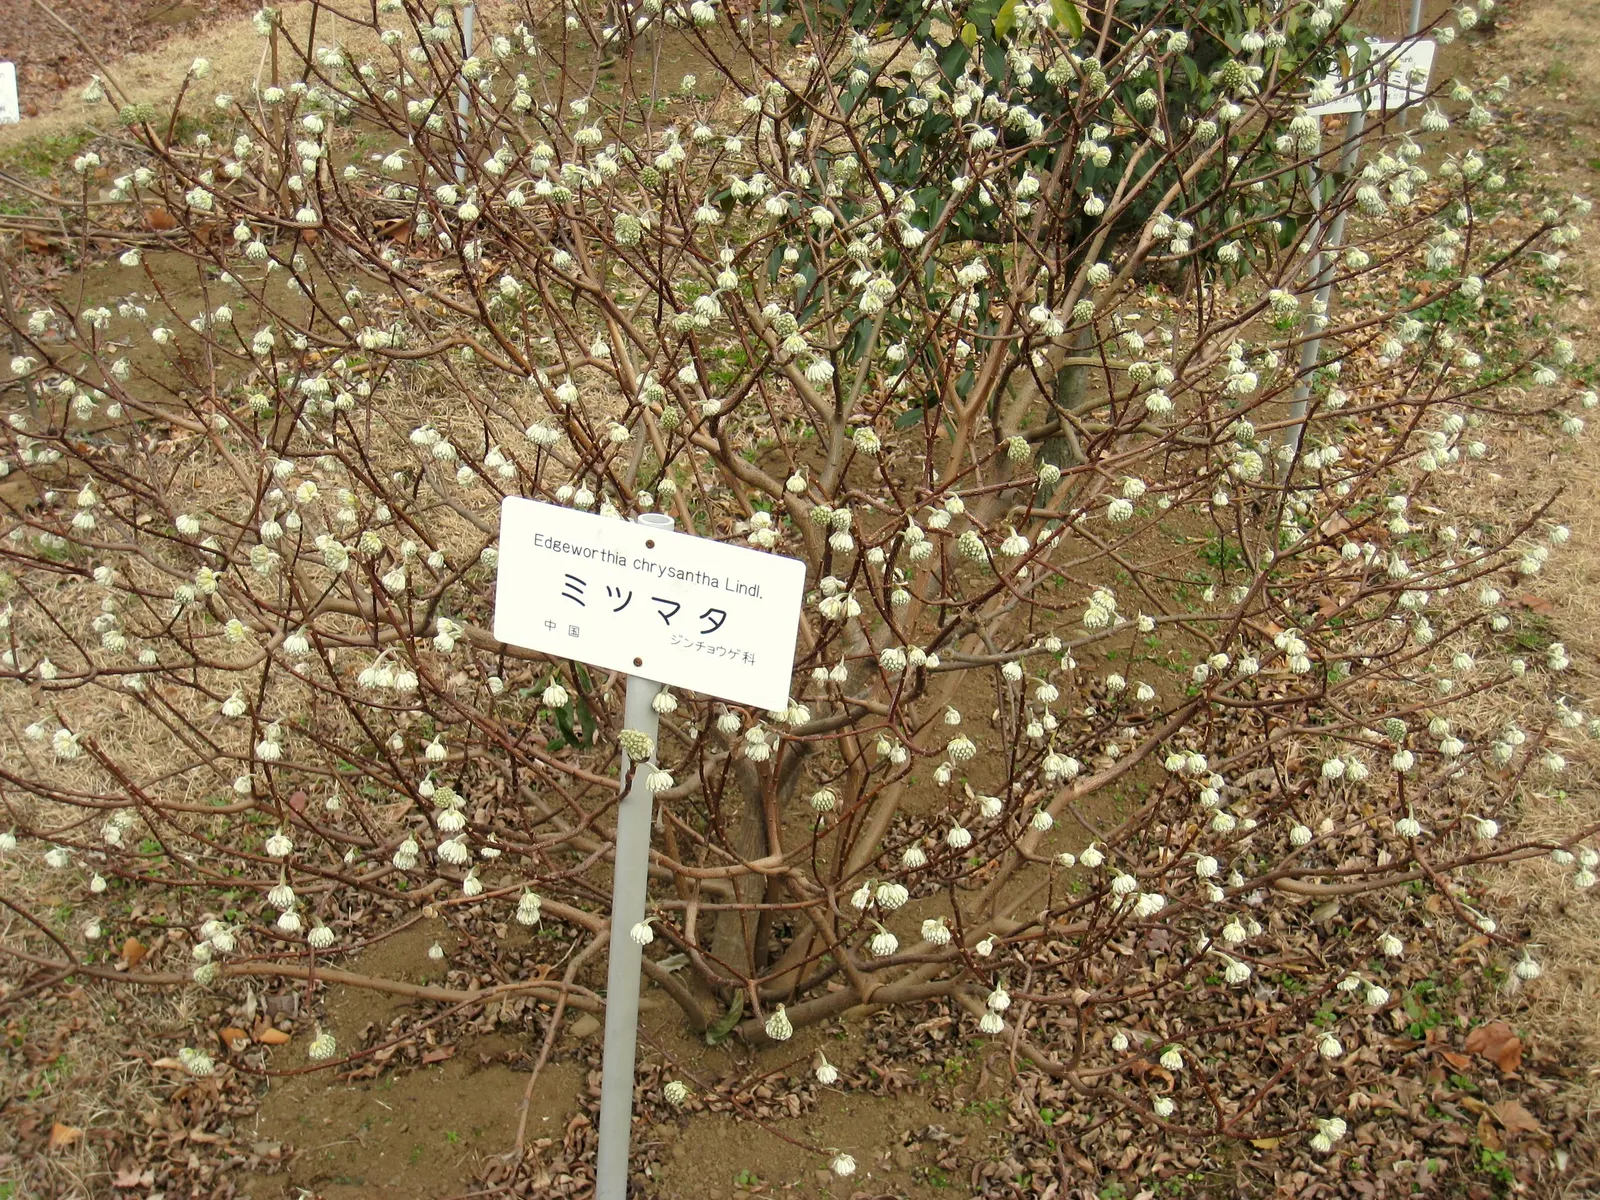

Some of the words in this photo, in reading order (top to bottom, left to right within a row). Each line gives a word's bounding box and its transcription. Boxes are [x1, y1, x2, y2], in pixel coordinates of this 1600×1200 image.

[534, 532, 627, 567] Edgeworthia
[633, 557, 719, 589] chrysantha
[725, 577, 763, 599] Lindl.
[561, 573, 728, 635] ミツマタ
[670, 633, 755, 666] ジンチョウゲ科
